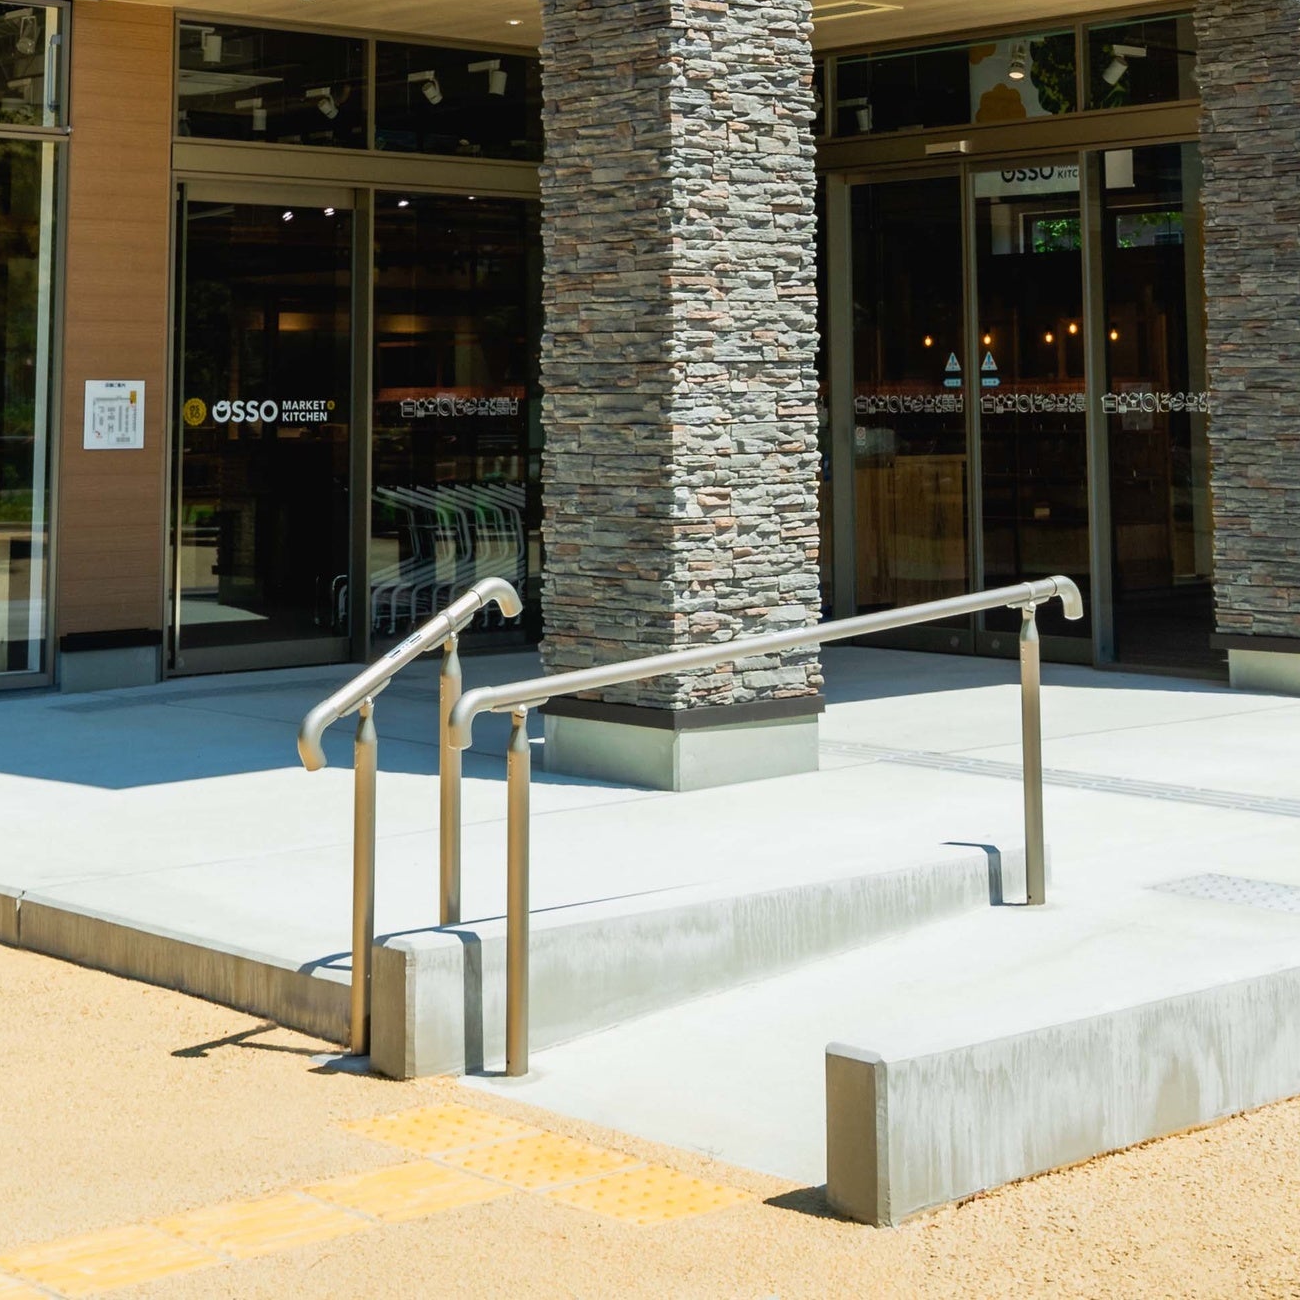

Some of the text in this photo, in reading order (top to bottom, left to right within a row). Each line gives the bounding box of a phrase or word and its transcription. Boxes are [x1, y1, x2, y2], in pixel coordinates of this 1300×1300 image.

[1057, 169, 1079, 179] KITC
[282, 401, 326, 410] MARKET
[282, 412, 328, 422] KITCHEN
